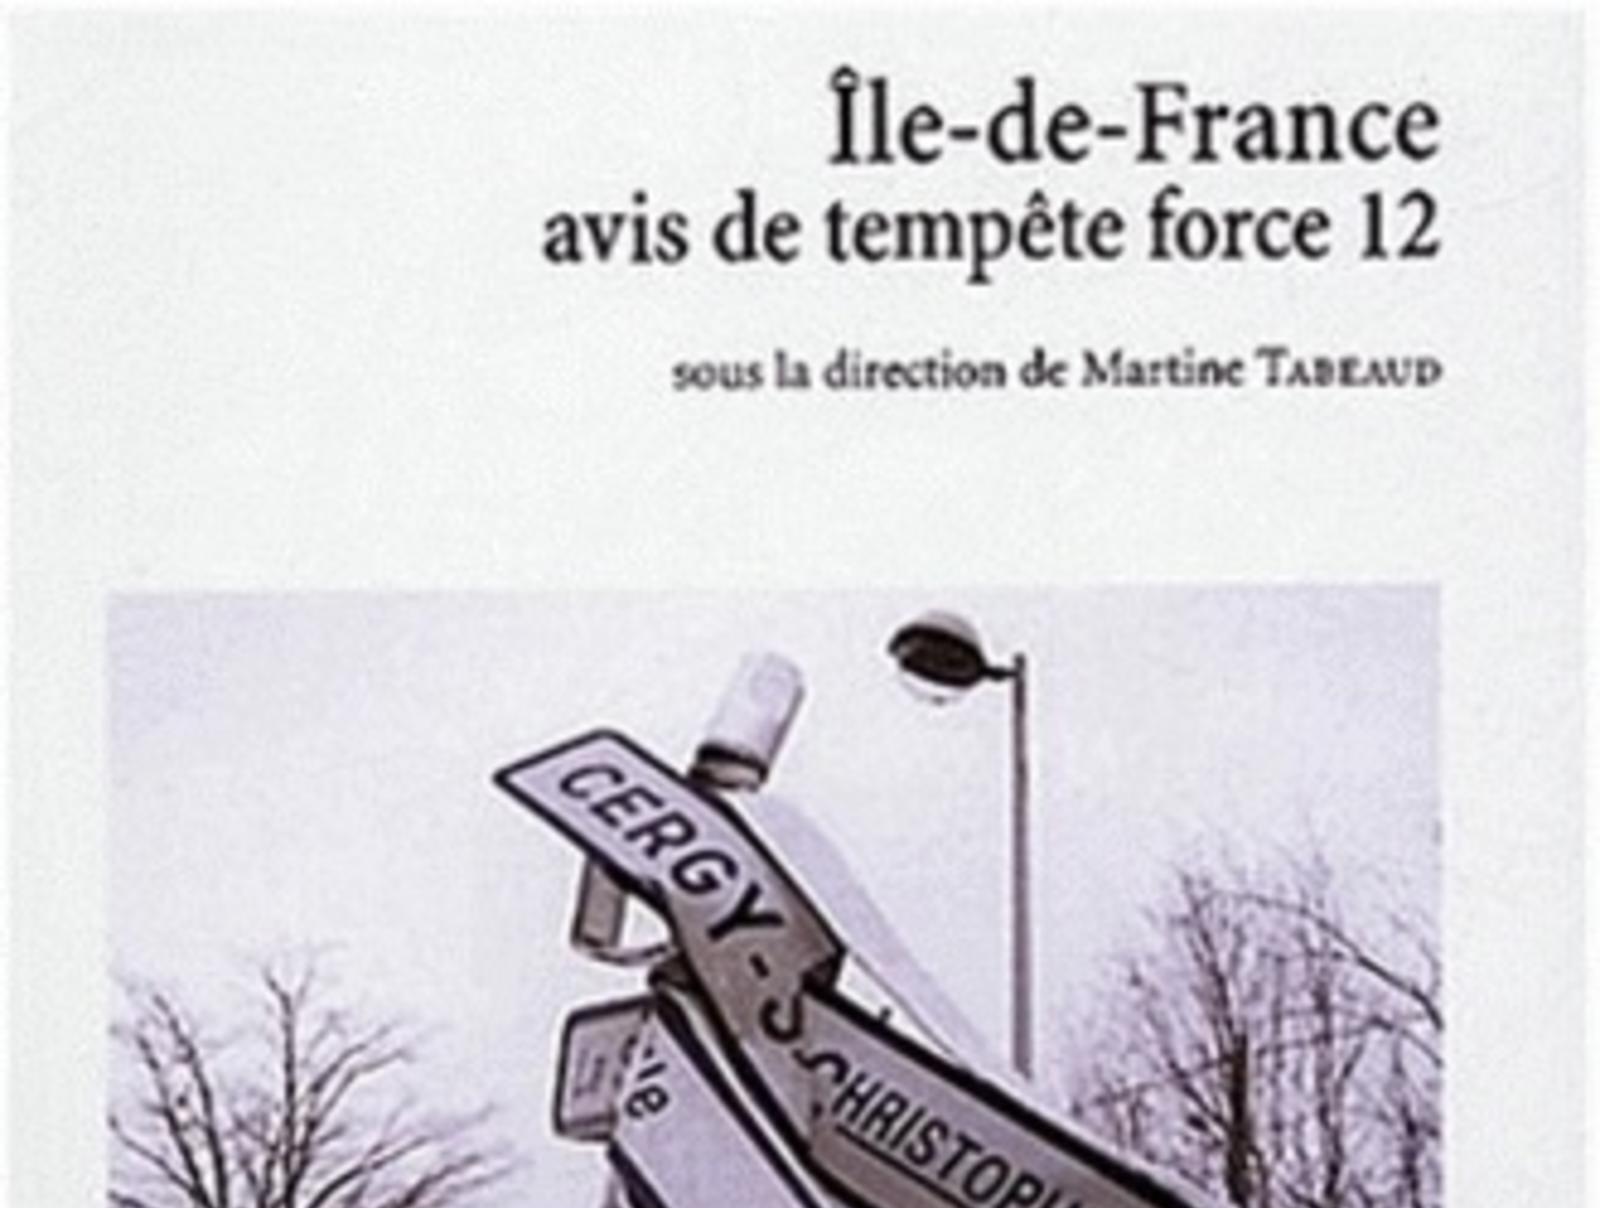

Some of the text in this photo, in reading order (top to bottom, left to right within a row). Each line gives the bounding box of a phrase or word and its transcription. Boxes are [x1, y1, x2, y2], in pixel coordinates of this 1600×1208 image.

[829, 65, 1440, 166] Île-de-France
[542, 184, 1440, 286] avis de tempête force 12
[673, 362, 764, 390] sous
[775, 350, 810, 389] la
[823, 348, 1008, 390] direction
[1019, 347, 1067, 388] de
[1082, 349, 1244, 388] Martine
[559, 764, 784, 943] CERGY
